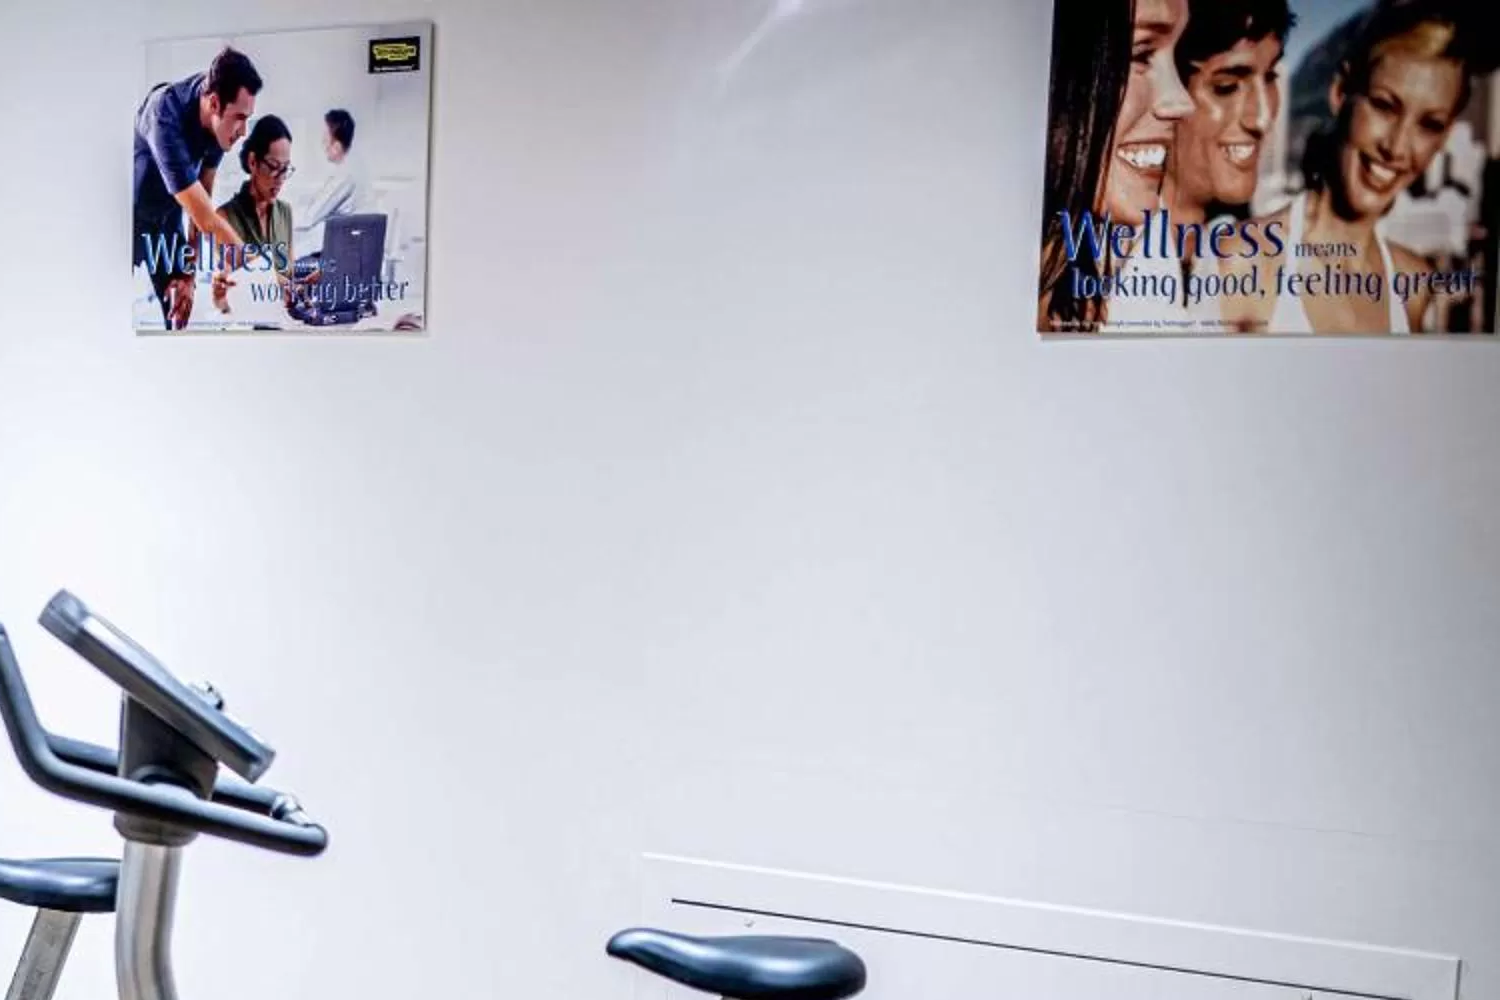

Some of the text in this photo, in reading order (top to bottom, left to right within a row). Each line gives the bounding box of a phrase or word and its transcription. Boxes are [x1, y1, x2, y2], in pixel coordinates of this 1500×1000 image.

[140, 231, 288, 275] Wellness
[1056, 207, 1358, 262] Wellness means
[1073, 263, 1478, 304] looking good, feeling great
